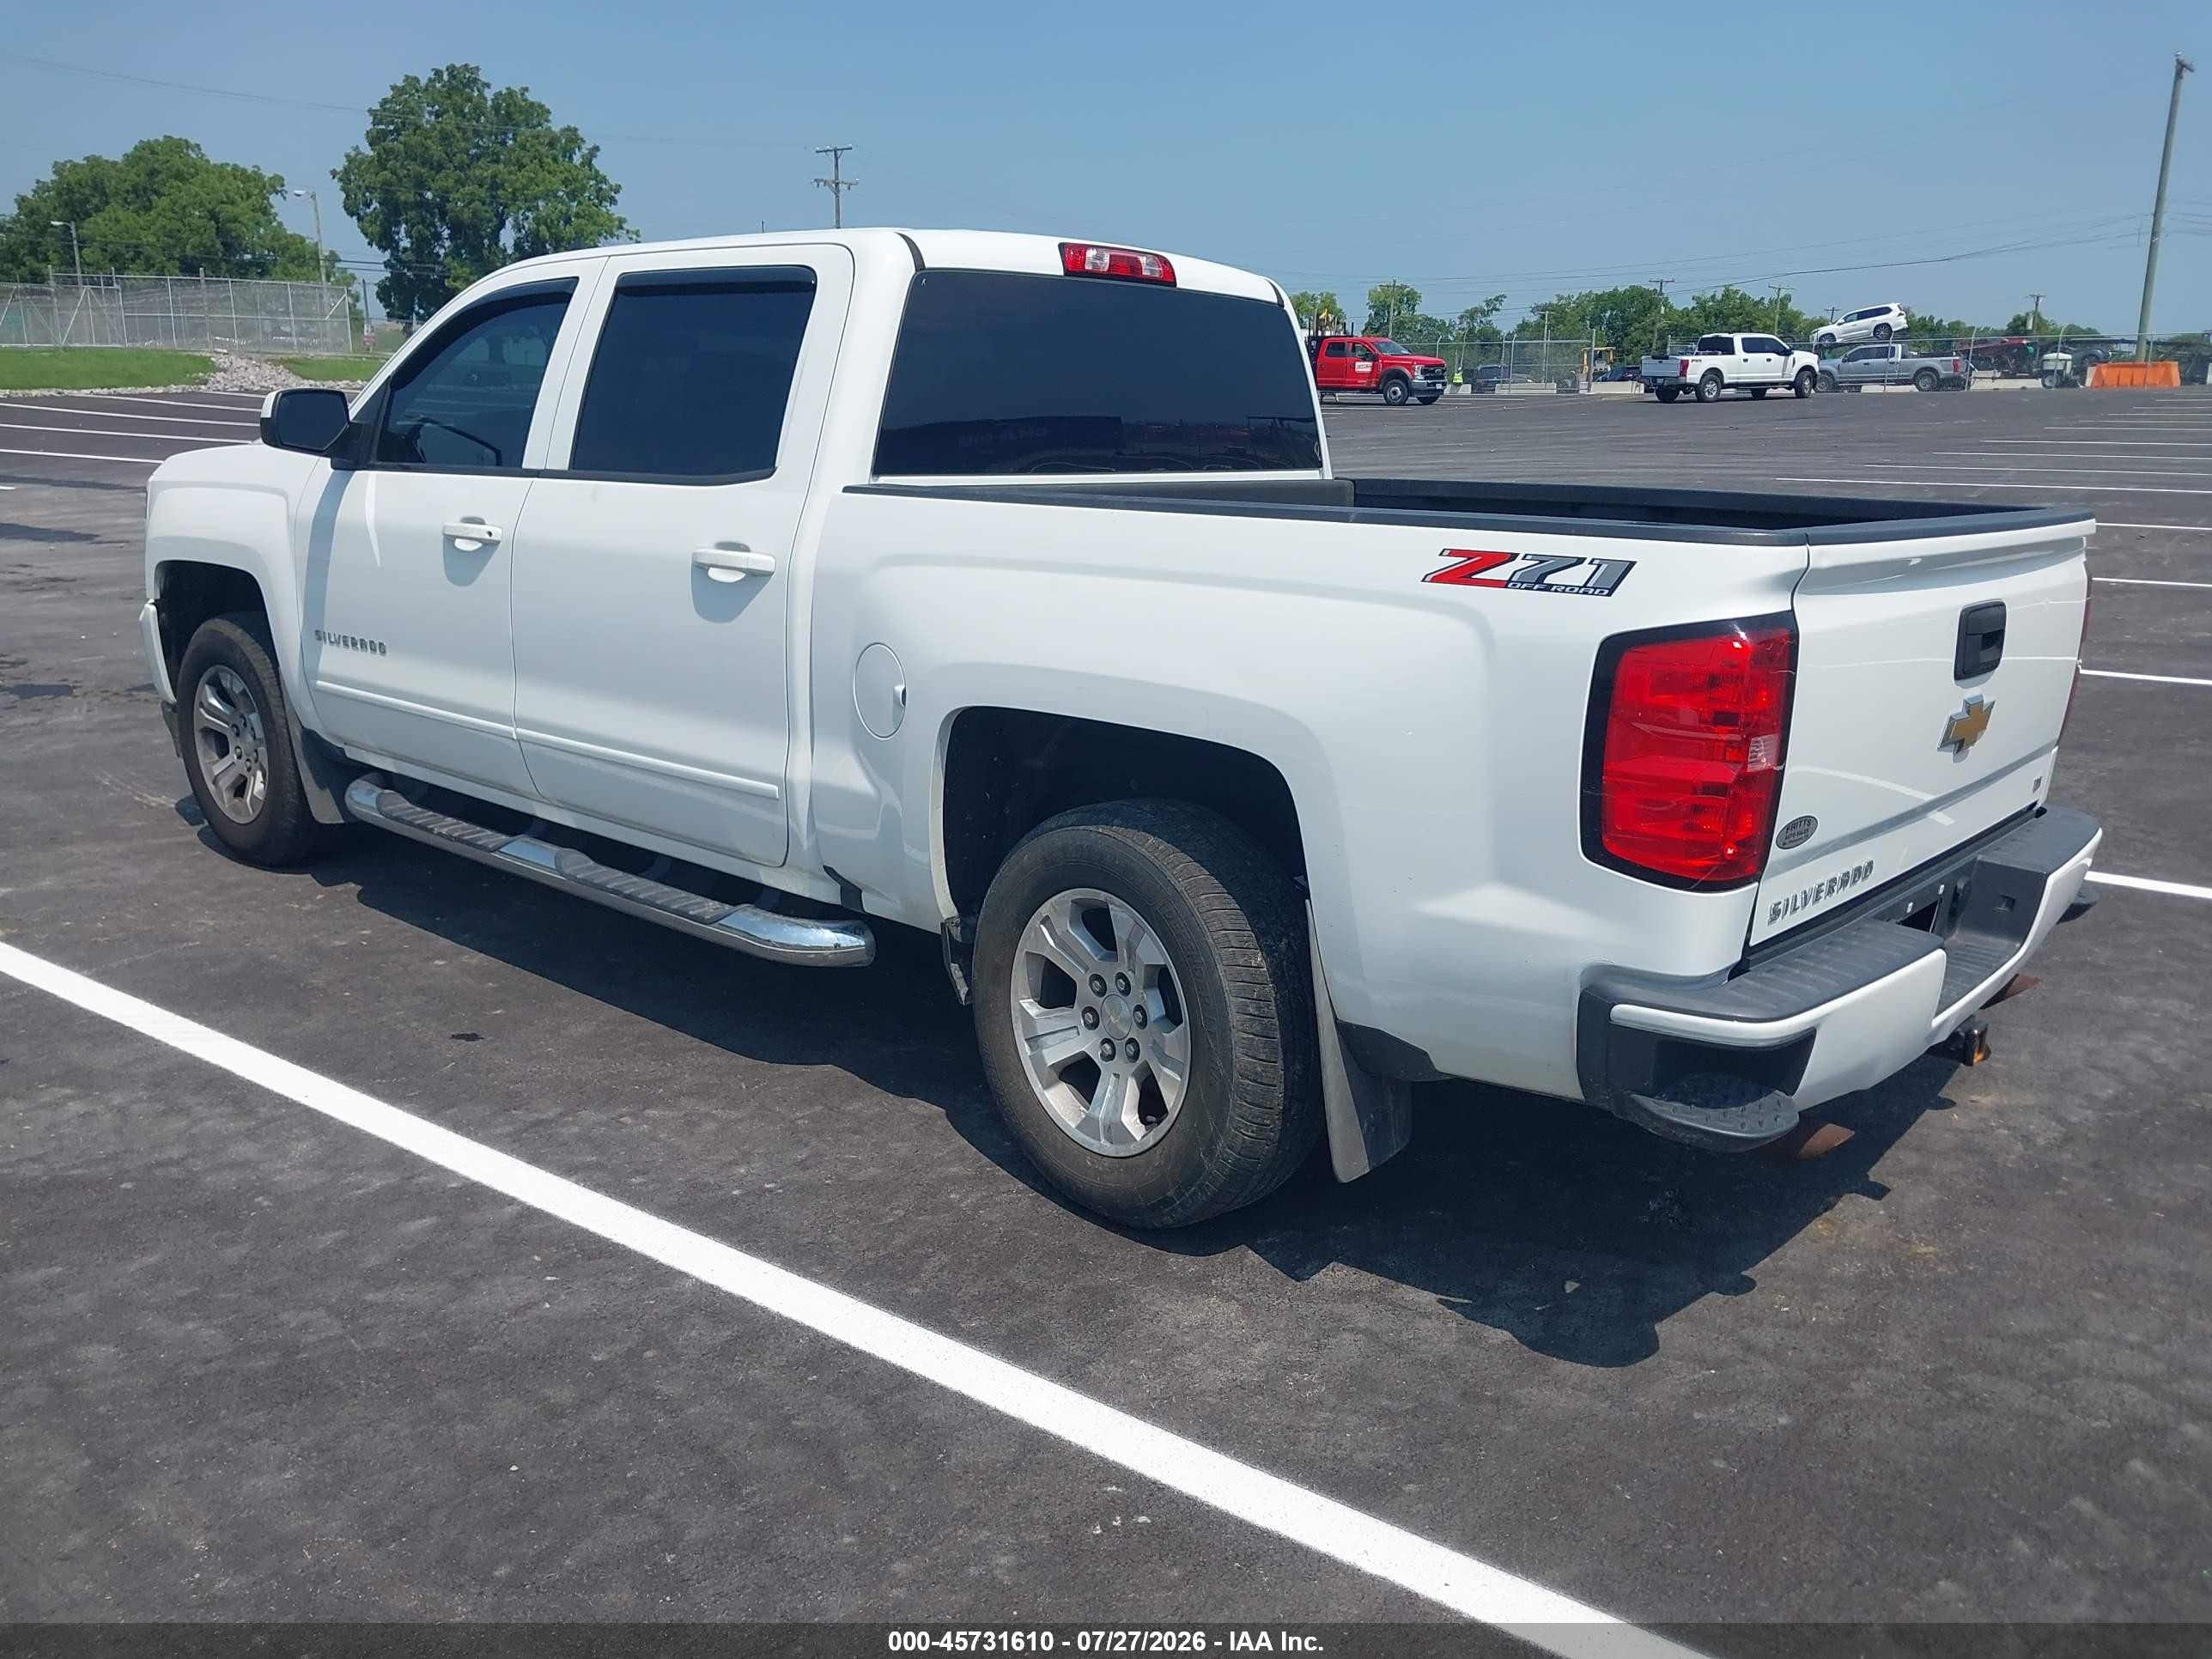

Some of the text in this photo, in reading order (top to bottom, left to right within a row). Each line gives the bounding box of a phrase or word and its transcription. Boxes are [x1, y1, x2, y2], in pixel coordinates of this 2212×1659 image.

[1421, 548, 1638, 591] Z71
[1507, 581, 1609, 596] OFF ROAD
[314, 629, 386, 657] SILVERADO
[1786, 818, 1812, 834] FRITTS
[1767, 860, 1875, 927] SILVERADO
